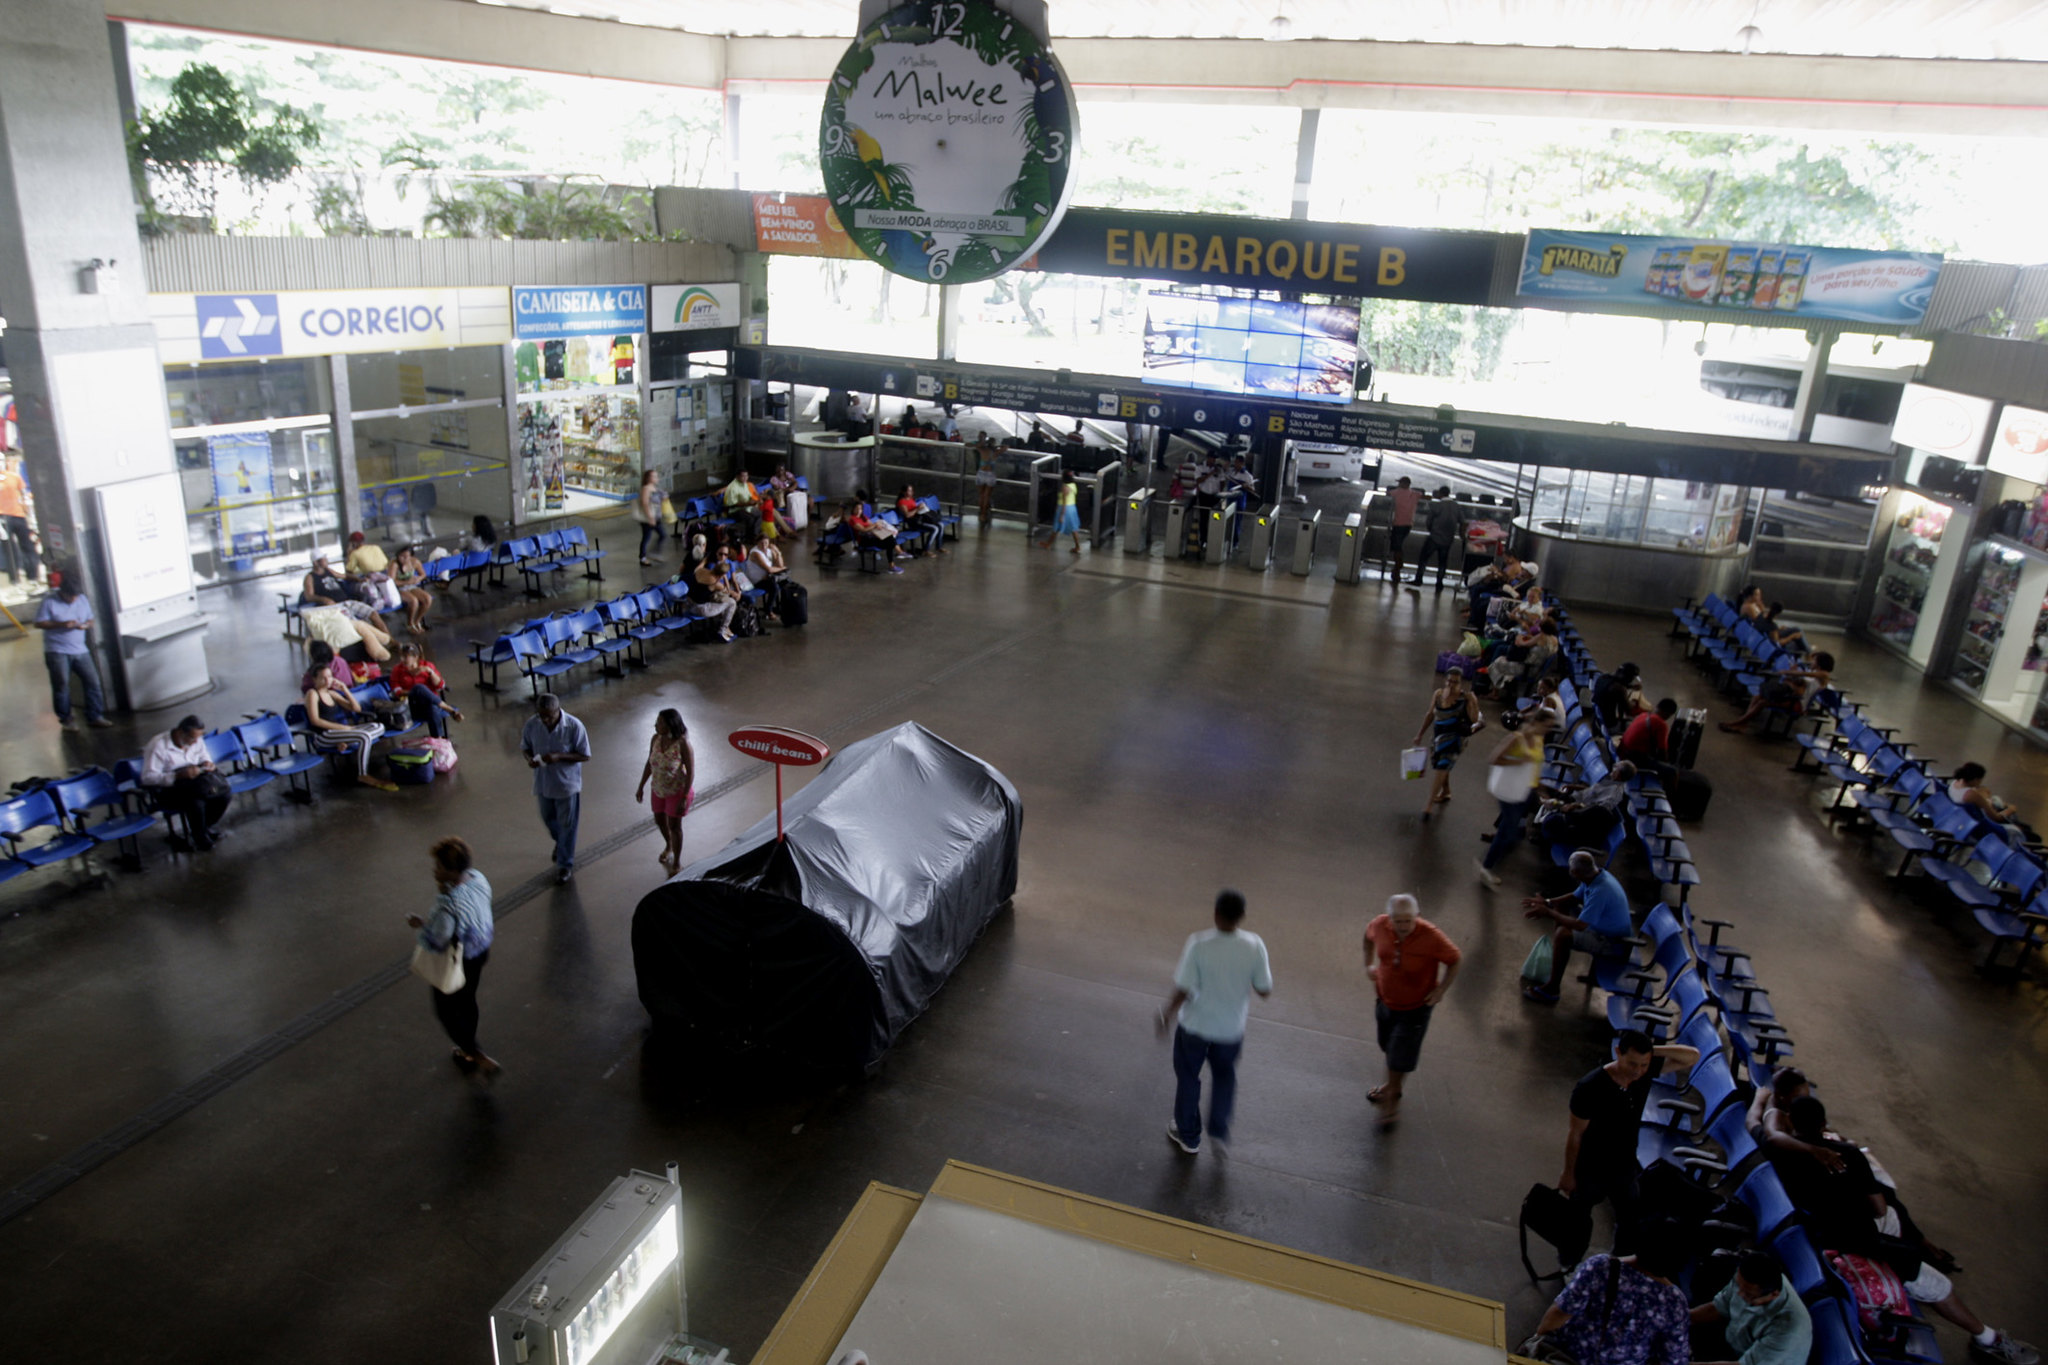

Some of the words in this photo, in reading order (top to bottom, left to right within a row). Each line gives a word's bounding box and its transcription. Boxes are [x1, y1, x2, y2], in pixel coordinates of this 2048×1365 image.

[931, 2, 966, 35] 12
[873, 69, 1008, 108] Malwee
[874, 111, 895, 121] um
[898, 106, 943, 124] abraço
[947, 108, 1005, 125] brasileiro
[825, 124, 844, 155] 9
[1043, 131, 1066, 163] 3
[760, 205, 779, 217] MEU
[761, 218, 815, 231] BEM-VINDO
[868, 214, 896, 226] Nossa
[897, 215, 932, 228] MODA
[933, 217, 967, 231] abraça
[968, 222, 977, 230] o
[762, 230, 770, 241] A
[928, 249, 949, 280] 6
[1106, 229, 1361, 283] EMBARQUE
[1377, 247, 1408, 286] B
[1555, 247, 1621, 275] MARATÁ
[1810, 272, 1834, 285] Uma
[1836, 266, 1871, 279] porção
[1872, 265, 1886, 275] de
[1887, 263, 1928, 277] saúde
[1823, 279, 1850, 292] para
[1851, 278, 1870, 288] seu
[518, 291, 602, 314] CAMISETA
[603, 290, 617, 312] &
[618, 290, 645, 311] CIA
[691, 304, 713, 315] ANTT
[300, 305, 445, 337] CORREIOS
[944, 383, 958, 400] B
[1120, 402, 1137, 417] B
[1290, 410, 1319, 420] Nacional
[1267, 415, 1285, 433] B
[1289, 418, 1302, 427] São
[1303, 420, 1335, 431] Matheus
[1340, 425, 1366, 434] Rápido
[1367, 427, 1395, 437] Federal
[1341, 416, 1357, 424] Real
[1358, 418, 1390, 429] Expresso
[1288, 427, 1310, 436] Penha
[737, 739, 771, 753] chilli
[772, 745, 812, 760] beans
